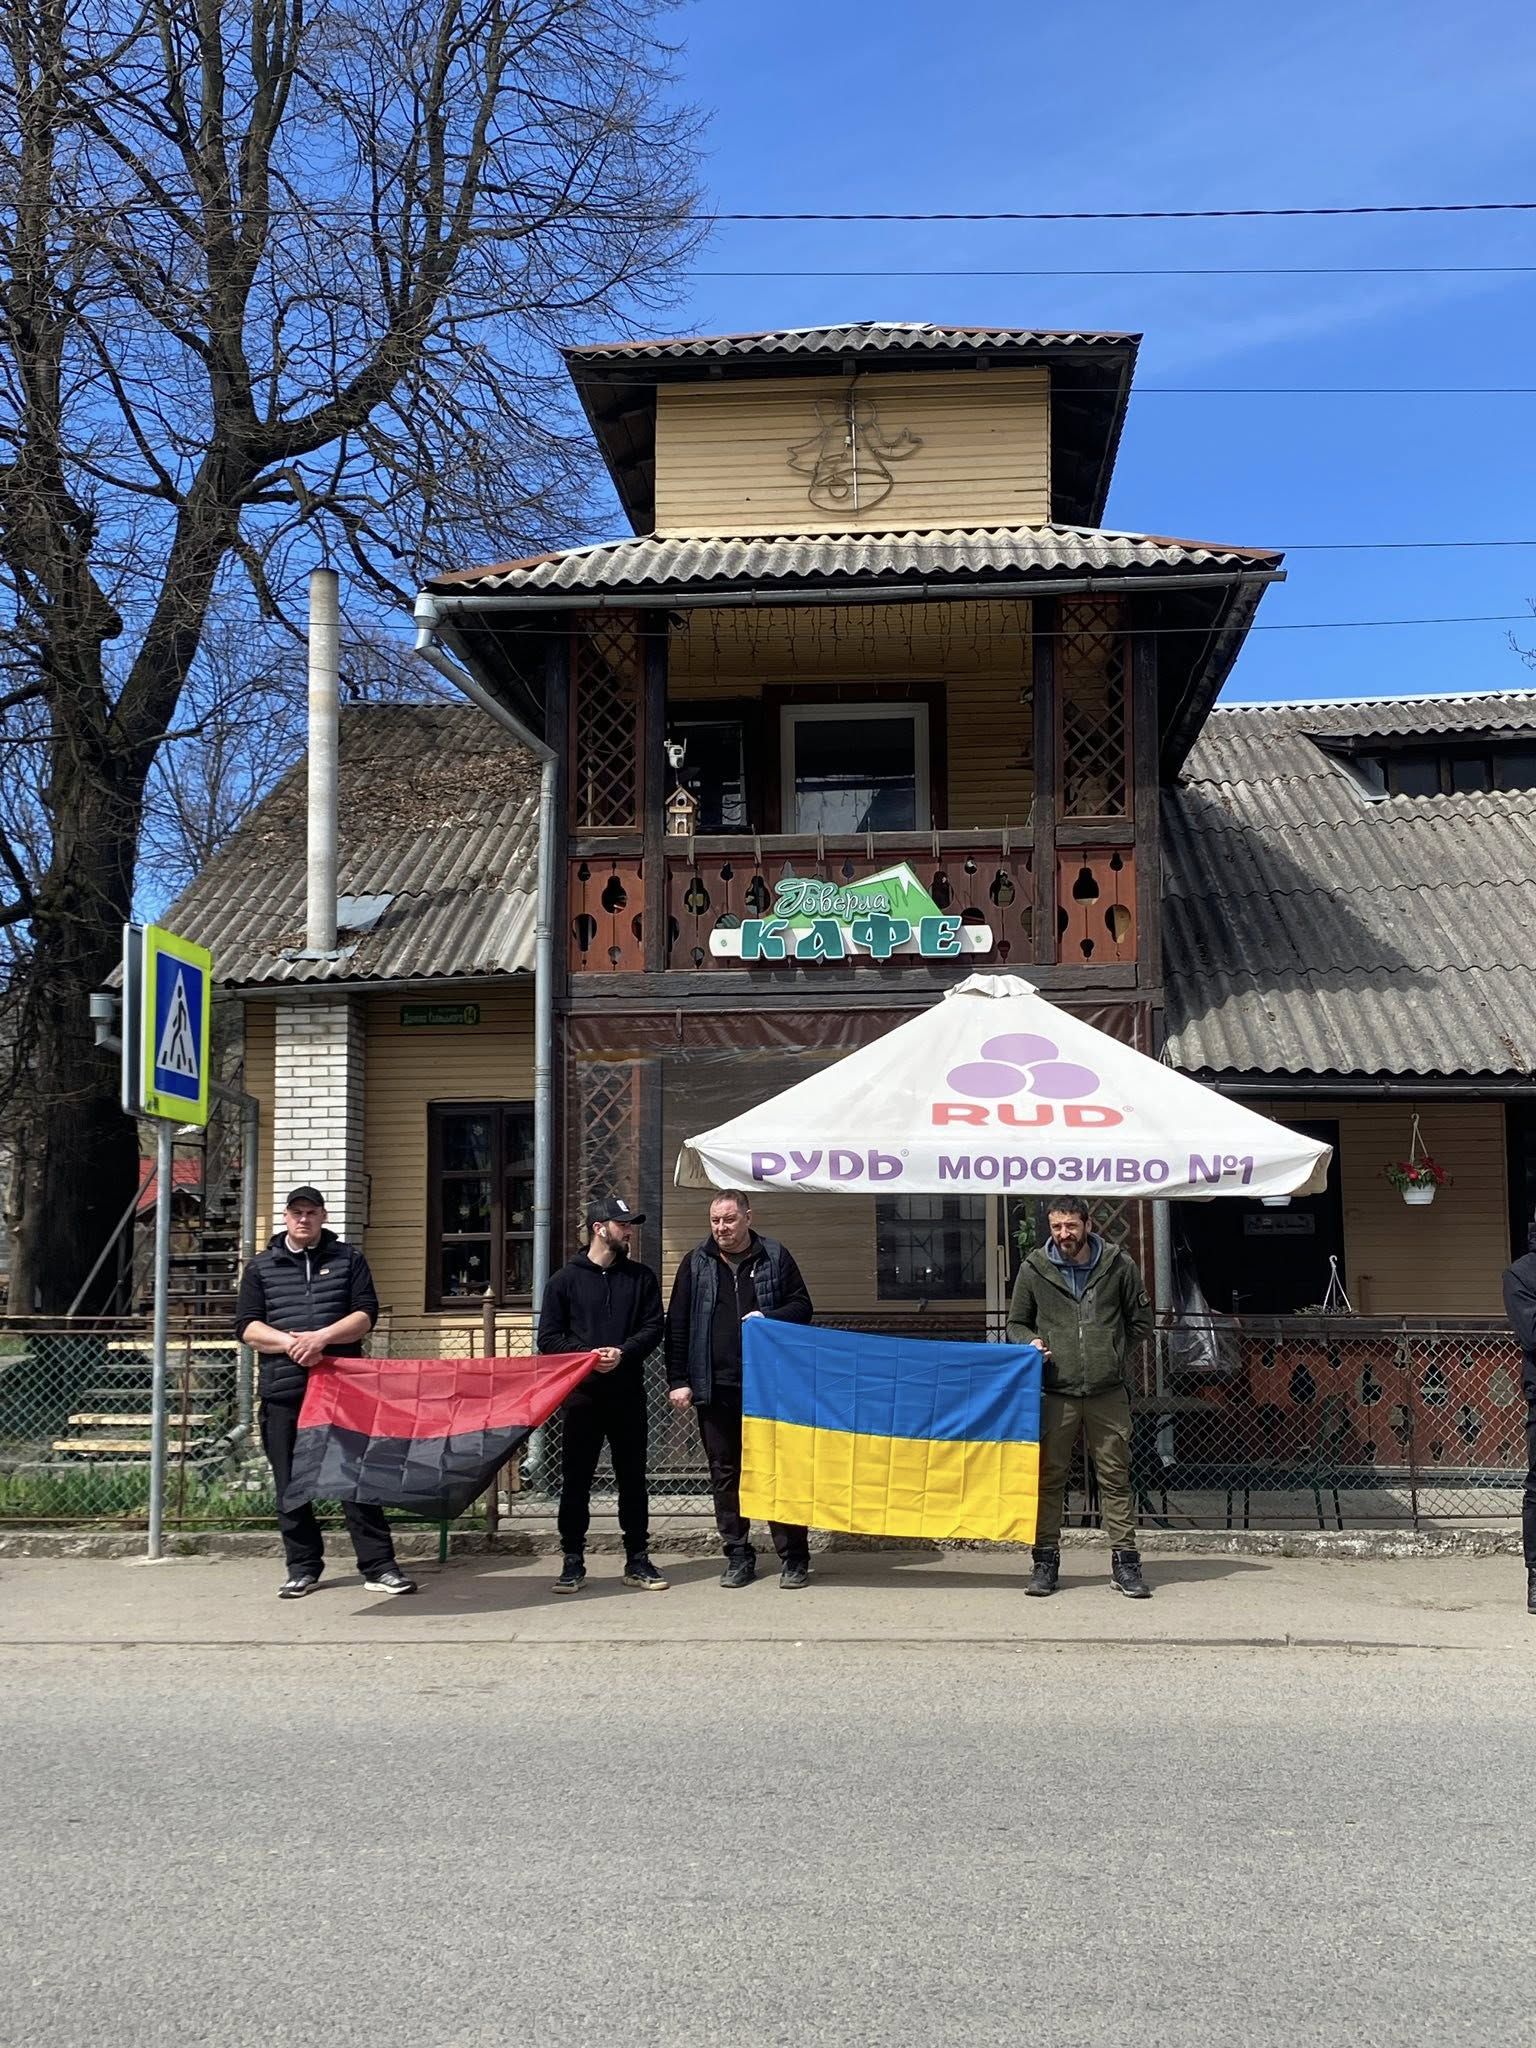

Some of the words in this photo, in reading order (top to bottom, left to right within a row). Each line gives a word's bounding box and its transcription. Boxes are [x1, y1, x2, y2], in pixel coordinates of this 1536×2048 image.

[774, 878, 890, 920] Говерла
[740, 914, 962, 959] КАФЕ
[932, 1103, 1124, 1127] RUD
[938, 1155, 1170, 1187] морозиво
